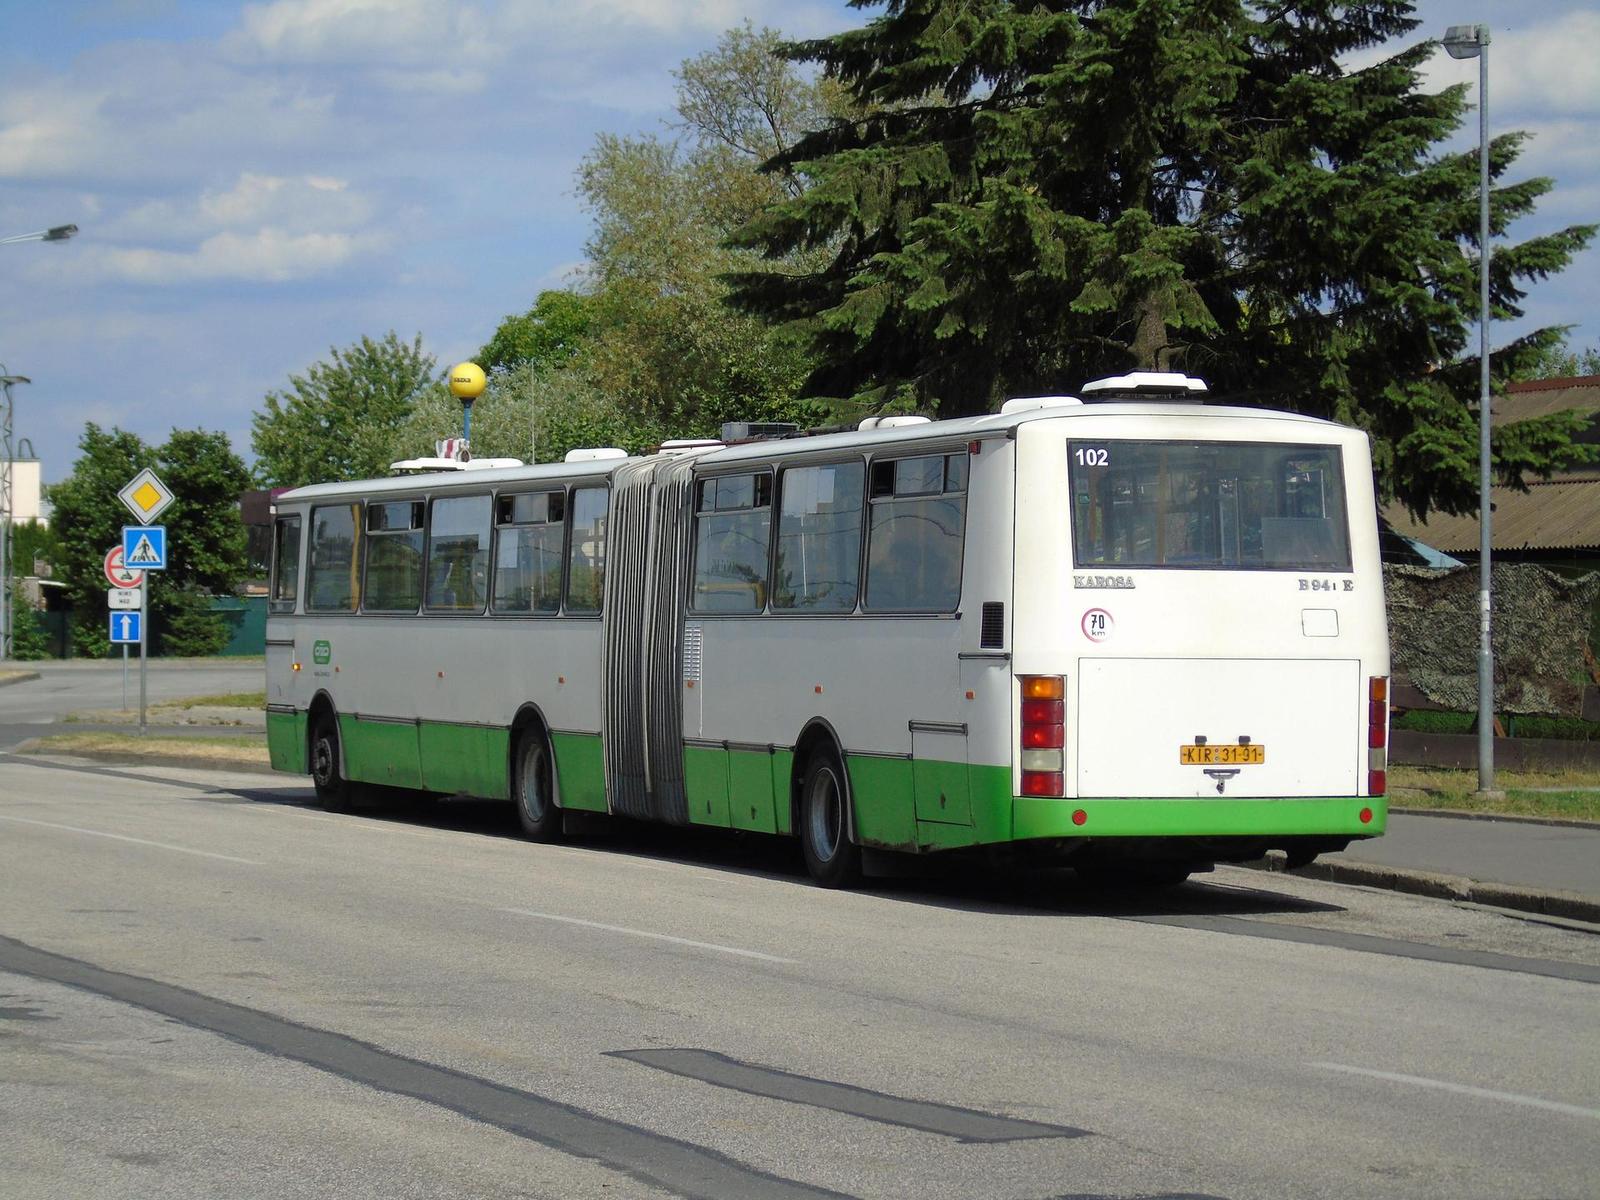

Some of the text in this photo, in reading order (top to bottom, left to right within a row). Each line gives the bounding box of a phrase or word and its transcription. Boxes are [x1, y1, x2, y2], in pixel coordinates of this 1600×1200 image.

[1075, 448, 1109, 466] 102
[1073, 576, 1136, 589] KAROSA
[1091, 614, 1105, 629] 70
[1187, 748, 1212, 762] KIR
